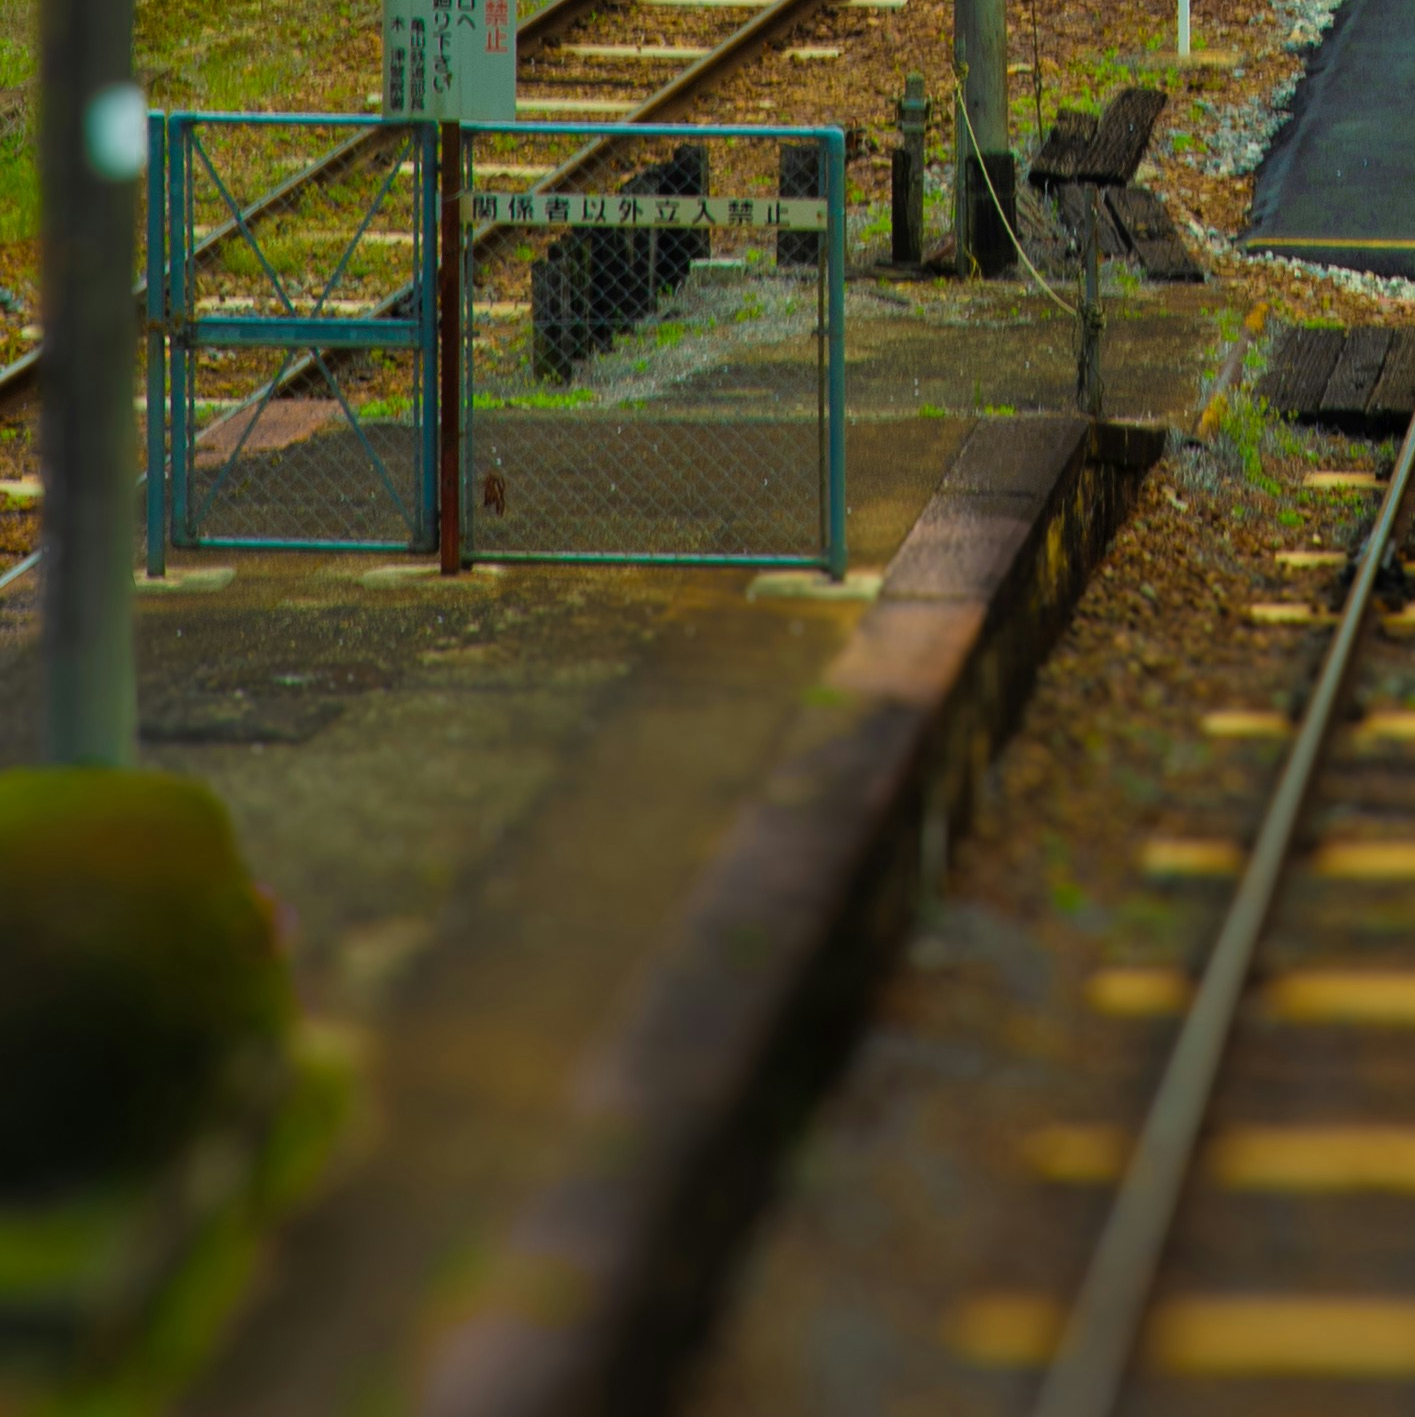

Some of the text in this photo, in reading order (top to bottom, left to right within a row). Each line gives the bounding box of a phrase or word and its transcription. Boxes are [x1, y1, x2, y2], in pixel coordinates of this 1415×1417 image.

[472, 194, 790, 227] 関係者以外立入禁止
